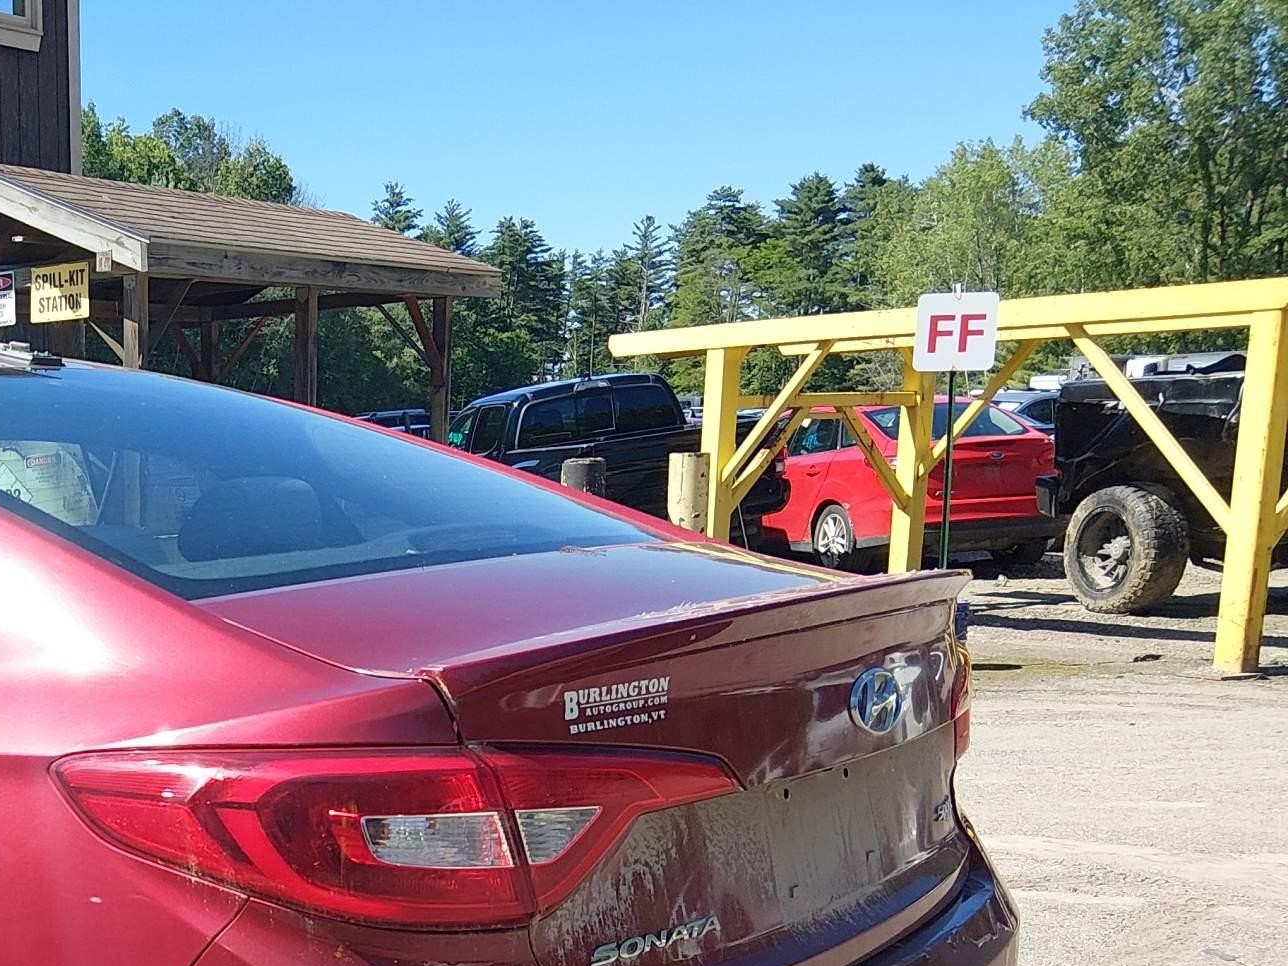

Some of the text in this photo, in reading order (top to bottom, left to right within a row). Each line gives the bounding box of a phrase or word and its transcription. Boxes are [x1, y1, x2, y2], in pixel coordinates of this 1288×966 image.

[34, 268, 85, 291] SPILL-KIT
[38, 292, 82, 314] STATION
[927, 313, 987, 354] FF
[564, 677, 669, 720] BURLINGTON
[585, 696, 668, 716] AUTOGROUP.COM
